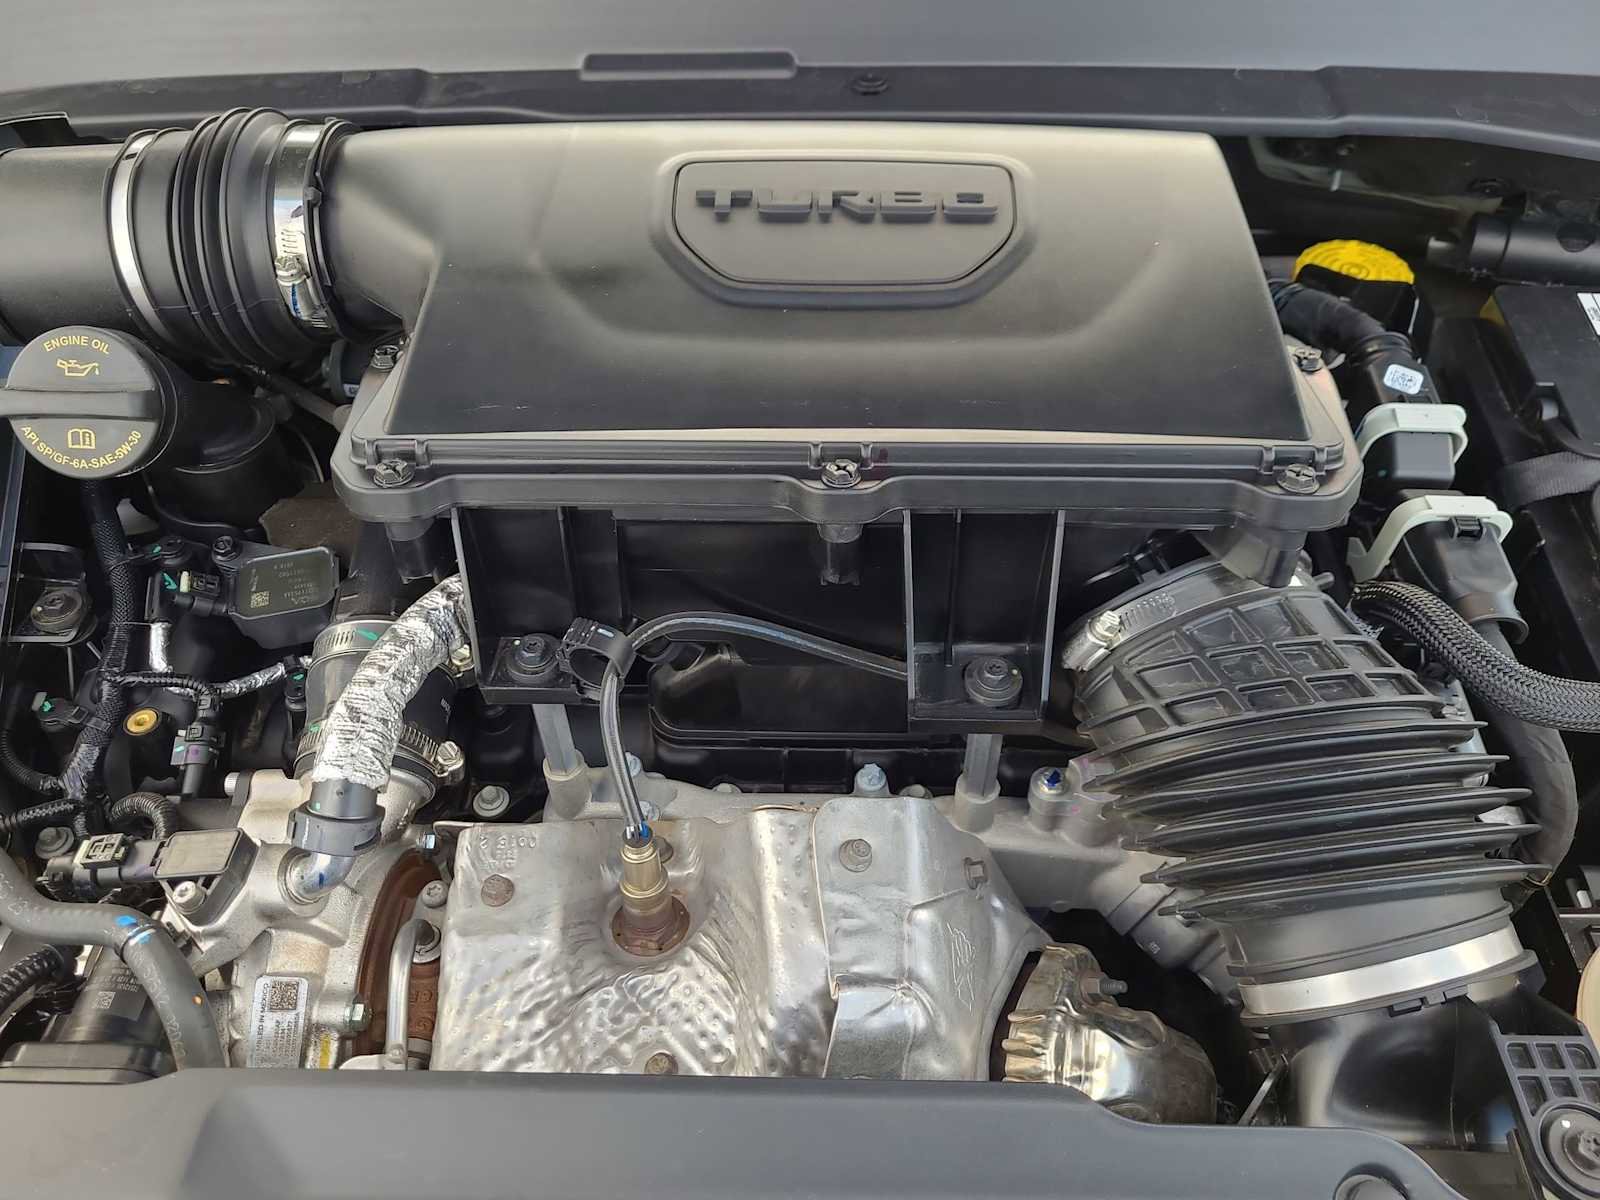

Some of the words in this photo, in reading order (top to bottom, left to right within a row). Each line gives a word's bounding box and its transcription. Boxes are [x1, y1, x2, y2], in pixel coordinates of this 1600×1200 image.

[695, 189, 998, 222] TURBO
[43, 335, 89, 352] ENGINE
[91, 339, 112, 355] OIL
[21, 424, 41, 446] API
